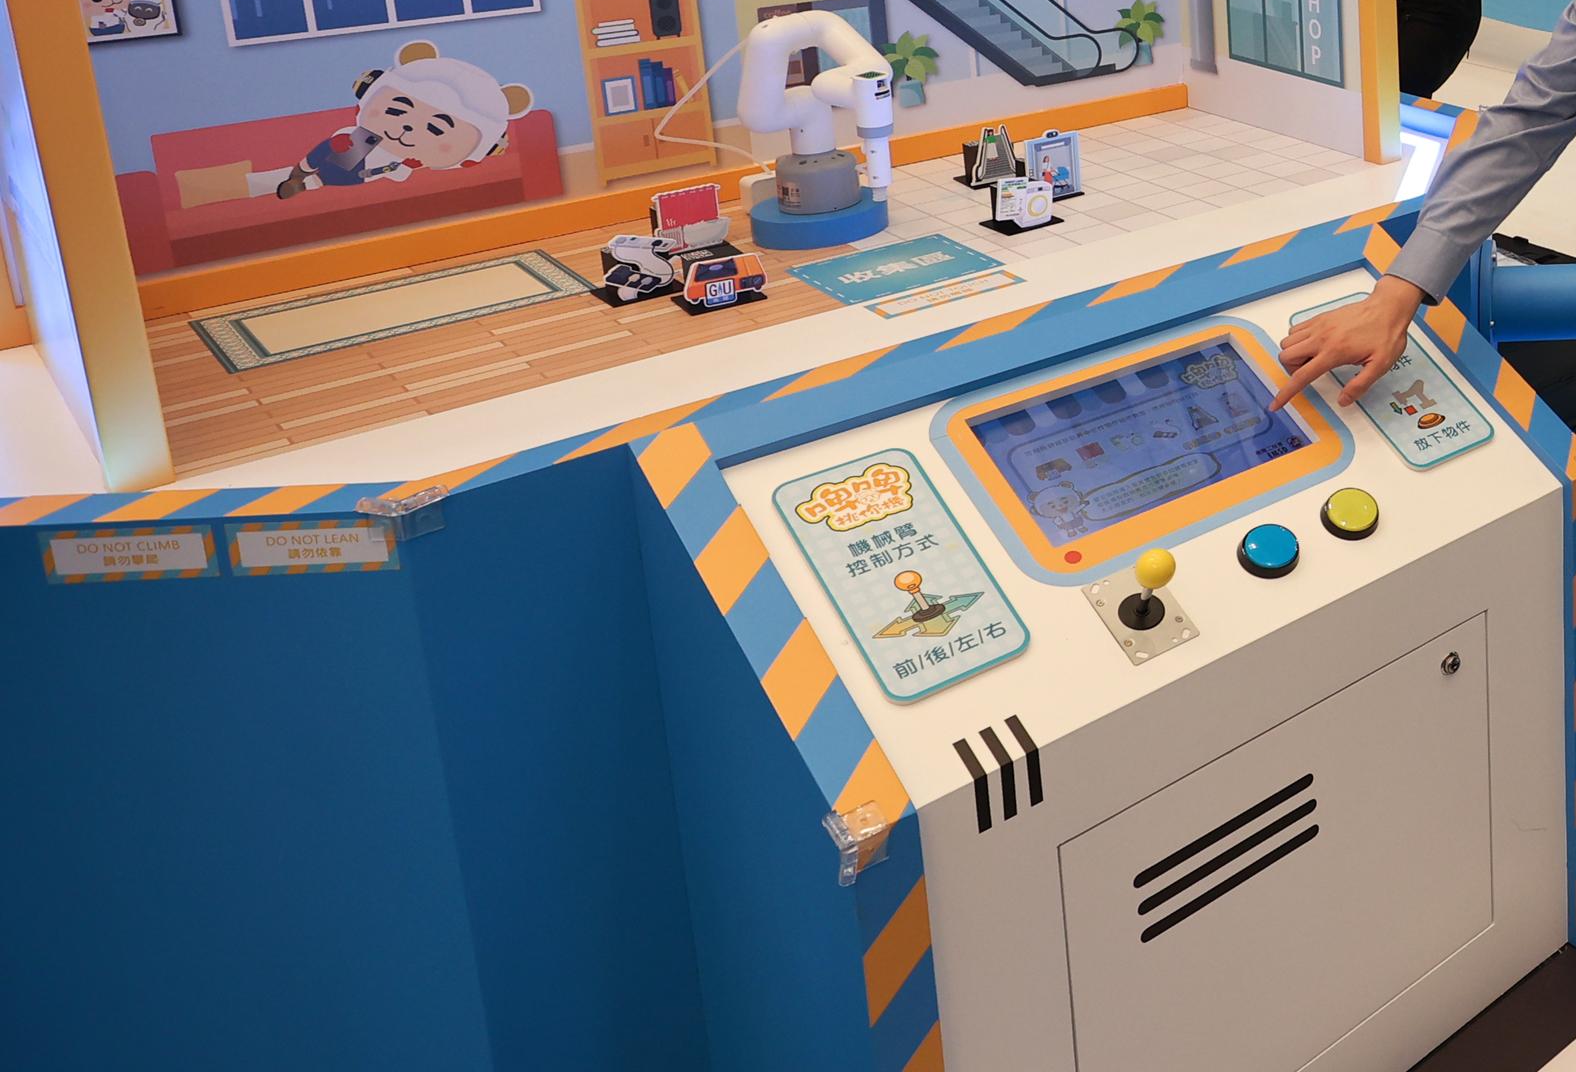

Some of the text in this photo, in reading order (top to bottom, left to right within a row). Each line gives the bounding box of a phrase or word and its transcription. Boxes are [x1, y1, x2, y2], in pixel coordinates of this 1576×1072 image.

[837, 250, 956, 285] 收集區
[1414, 420, 1471, 451] 放下物件
[77, 540, 181, 554] DO NOT CLIMB
[265, 533, 359, 546] DO NOT LEAN
[845, 534, 940, 578] 控制方式
[847, 522, 918, 558] 機械臂
[893, 621, 1008, 680] 前/後/左/右
